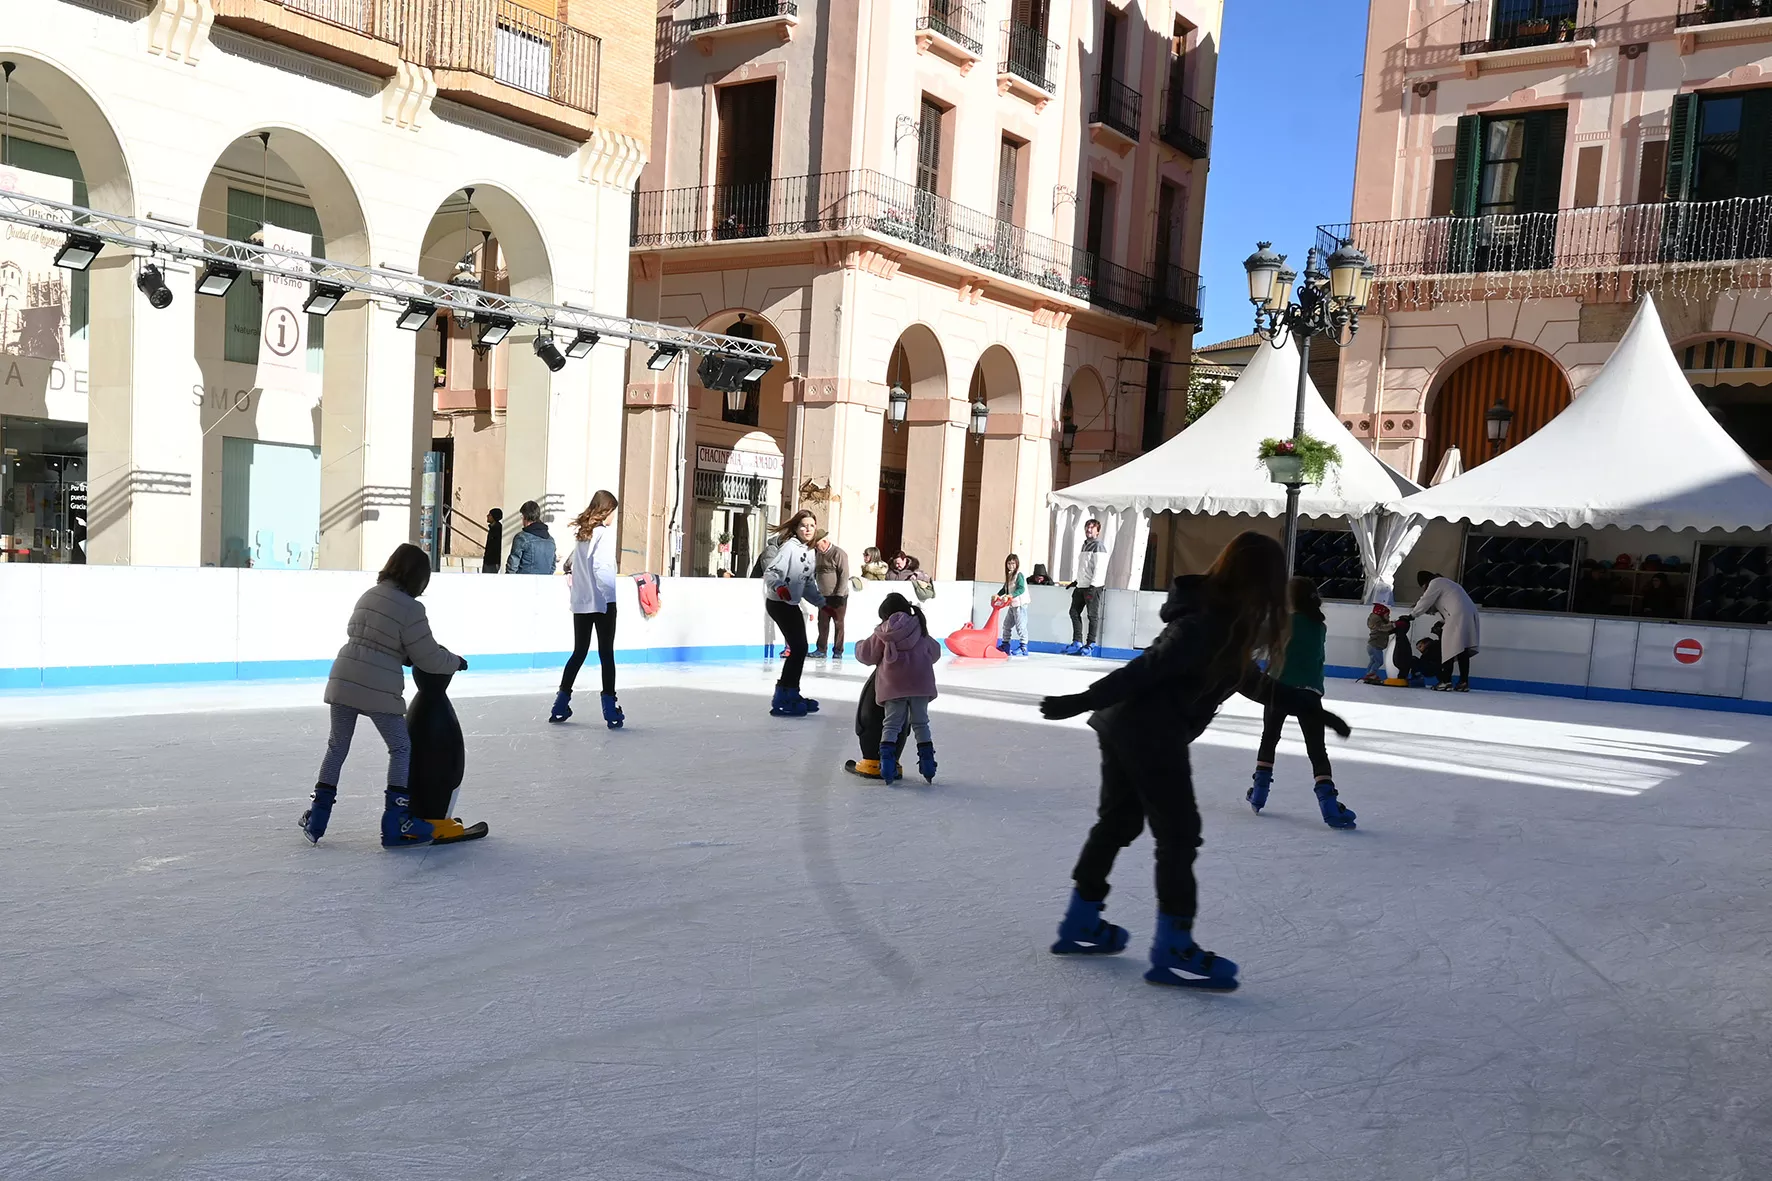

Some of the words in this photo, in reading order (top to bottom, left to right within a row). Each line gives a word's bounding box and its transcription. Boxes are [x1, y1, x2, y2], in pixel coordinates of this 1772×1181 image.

[49, 366, 88, 394] DE
[192, 384, 250, 412] SMO
[754, 455, 778, 470] AMADO
[70, 502, 87, 510] Gracia
